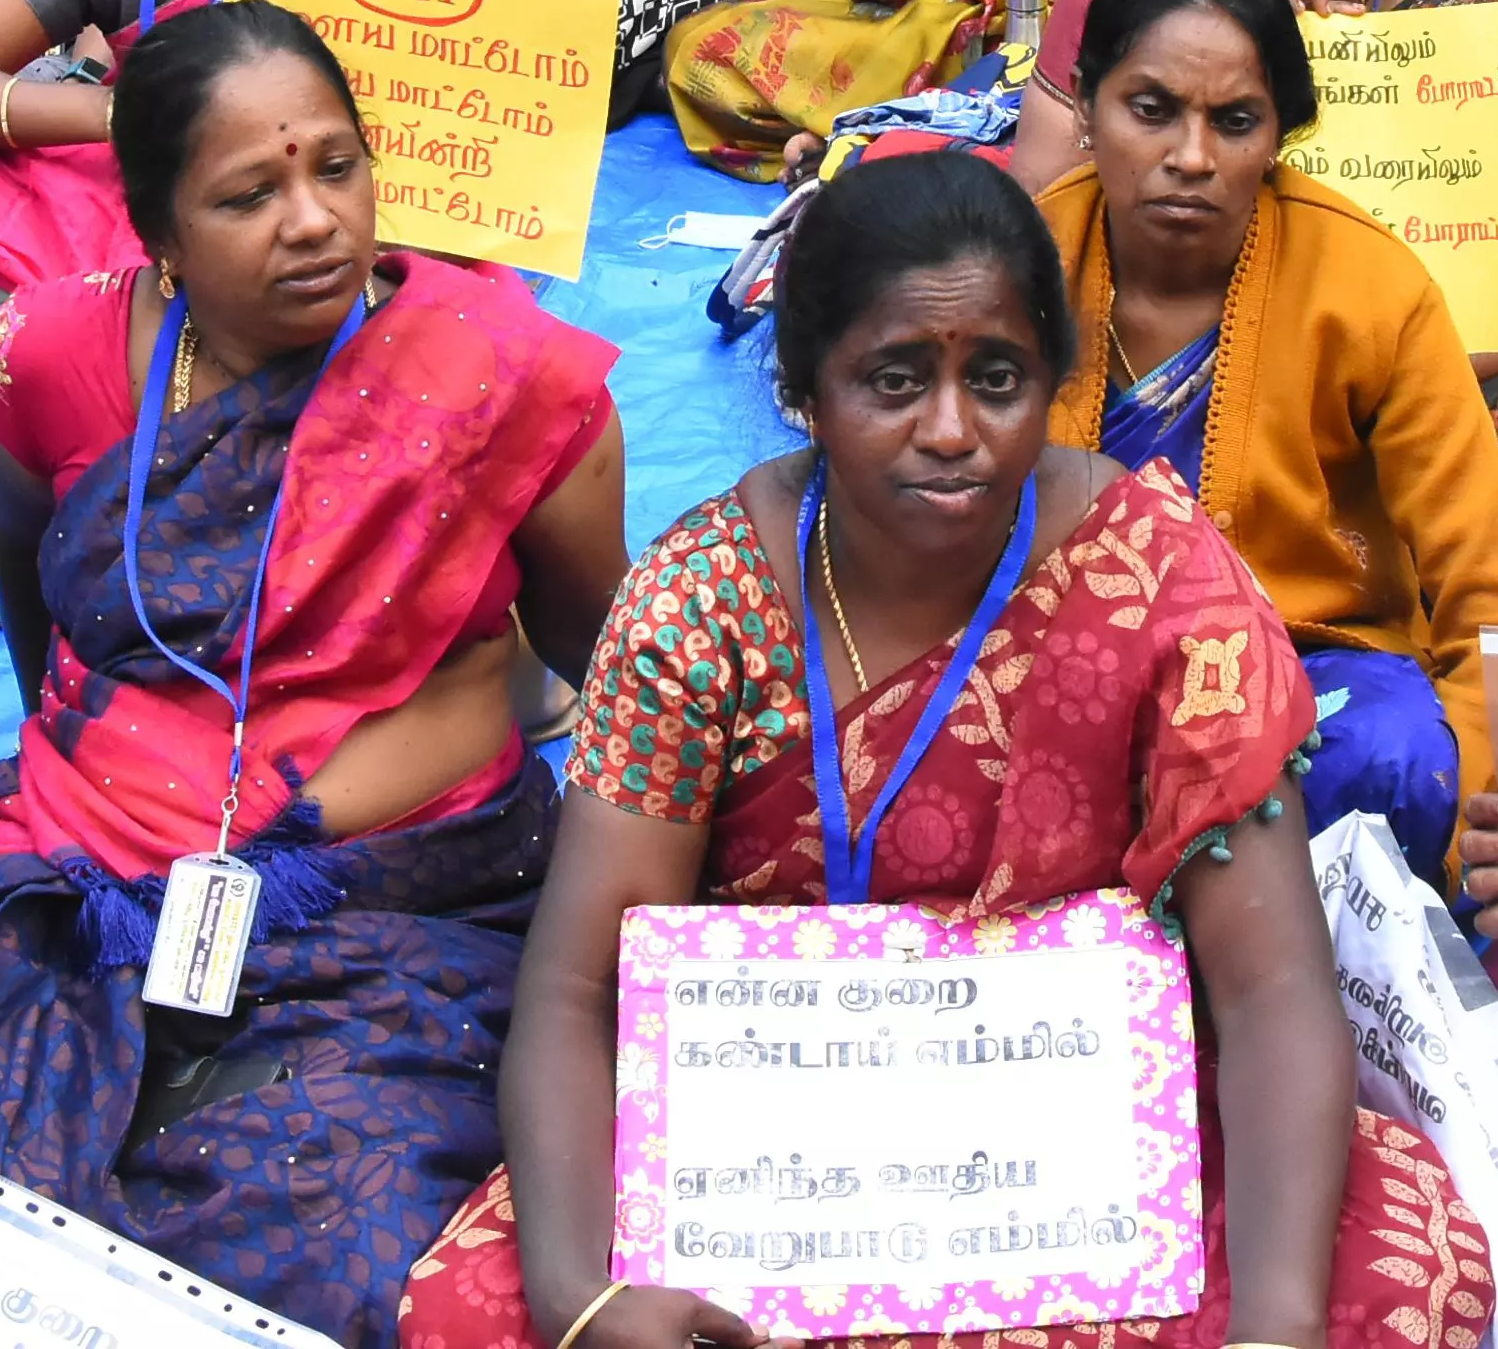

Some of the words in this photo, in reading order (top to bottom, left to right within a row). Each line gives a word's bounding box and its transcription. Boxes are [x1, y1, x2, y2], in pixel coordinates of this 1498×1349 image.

[410, 29, 590, 89] மாட்டோம்
[386, 78, 555, 138] மாட்டோம்
[375, 178, 545, 241] மாட்டோம்
[673, 964, 822, 1006] என்ன
[837, 975, 979, 1015] குறை
[673, 1026, 898, 1069] கண்டாய்
[915, 1017, 1101, 1067] எம்மில்
[877, 1150, 1038, 1201] ஊதிய
[672, 1221, 929, 1271] வேறுபாடு
[948, 1202, 1138, 1257] எம்மில்
